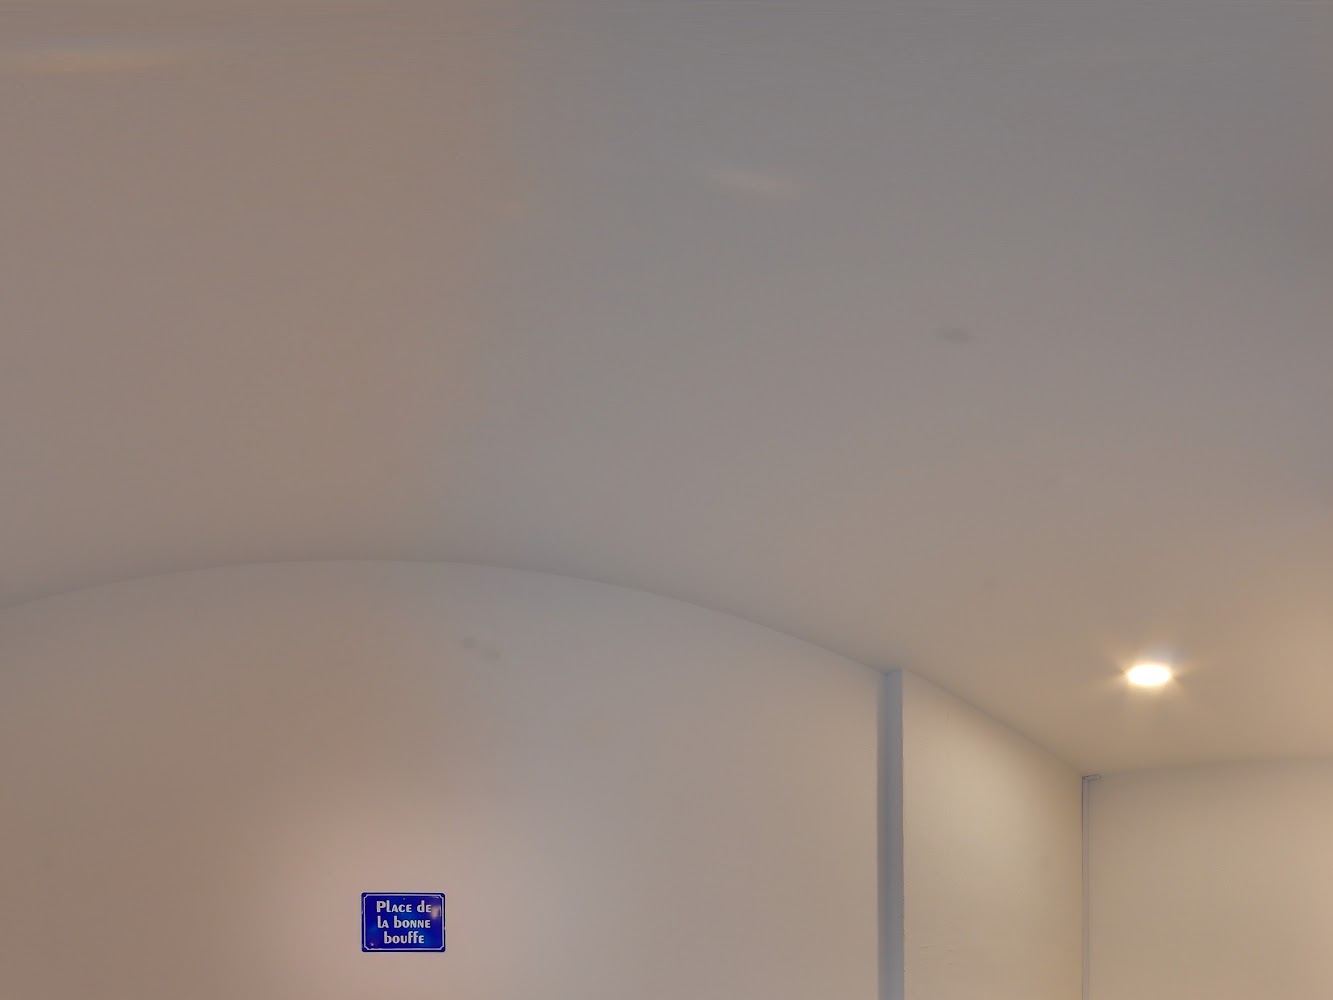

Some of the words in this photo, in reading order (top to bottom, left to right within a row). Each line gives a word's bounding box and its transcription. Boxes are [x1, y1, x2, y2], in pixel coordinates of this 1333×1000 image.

[376, 900, 412, 913] Place
[417, 900, 432, 913] de
[377, 916, 389, 929] la
[394, 916, 431, 928] bonne
[384, 931, 425, 944] bouffe
